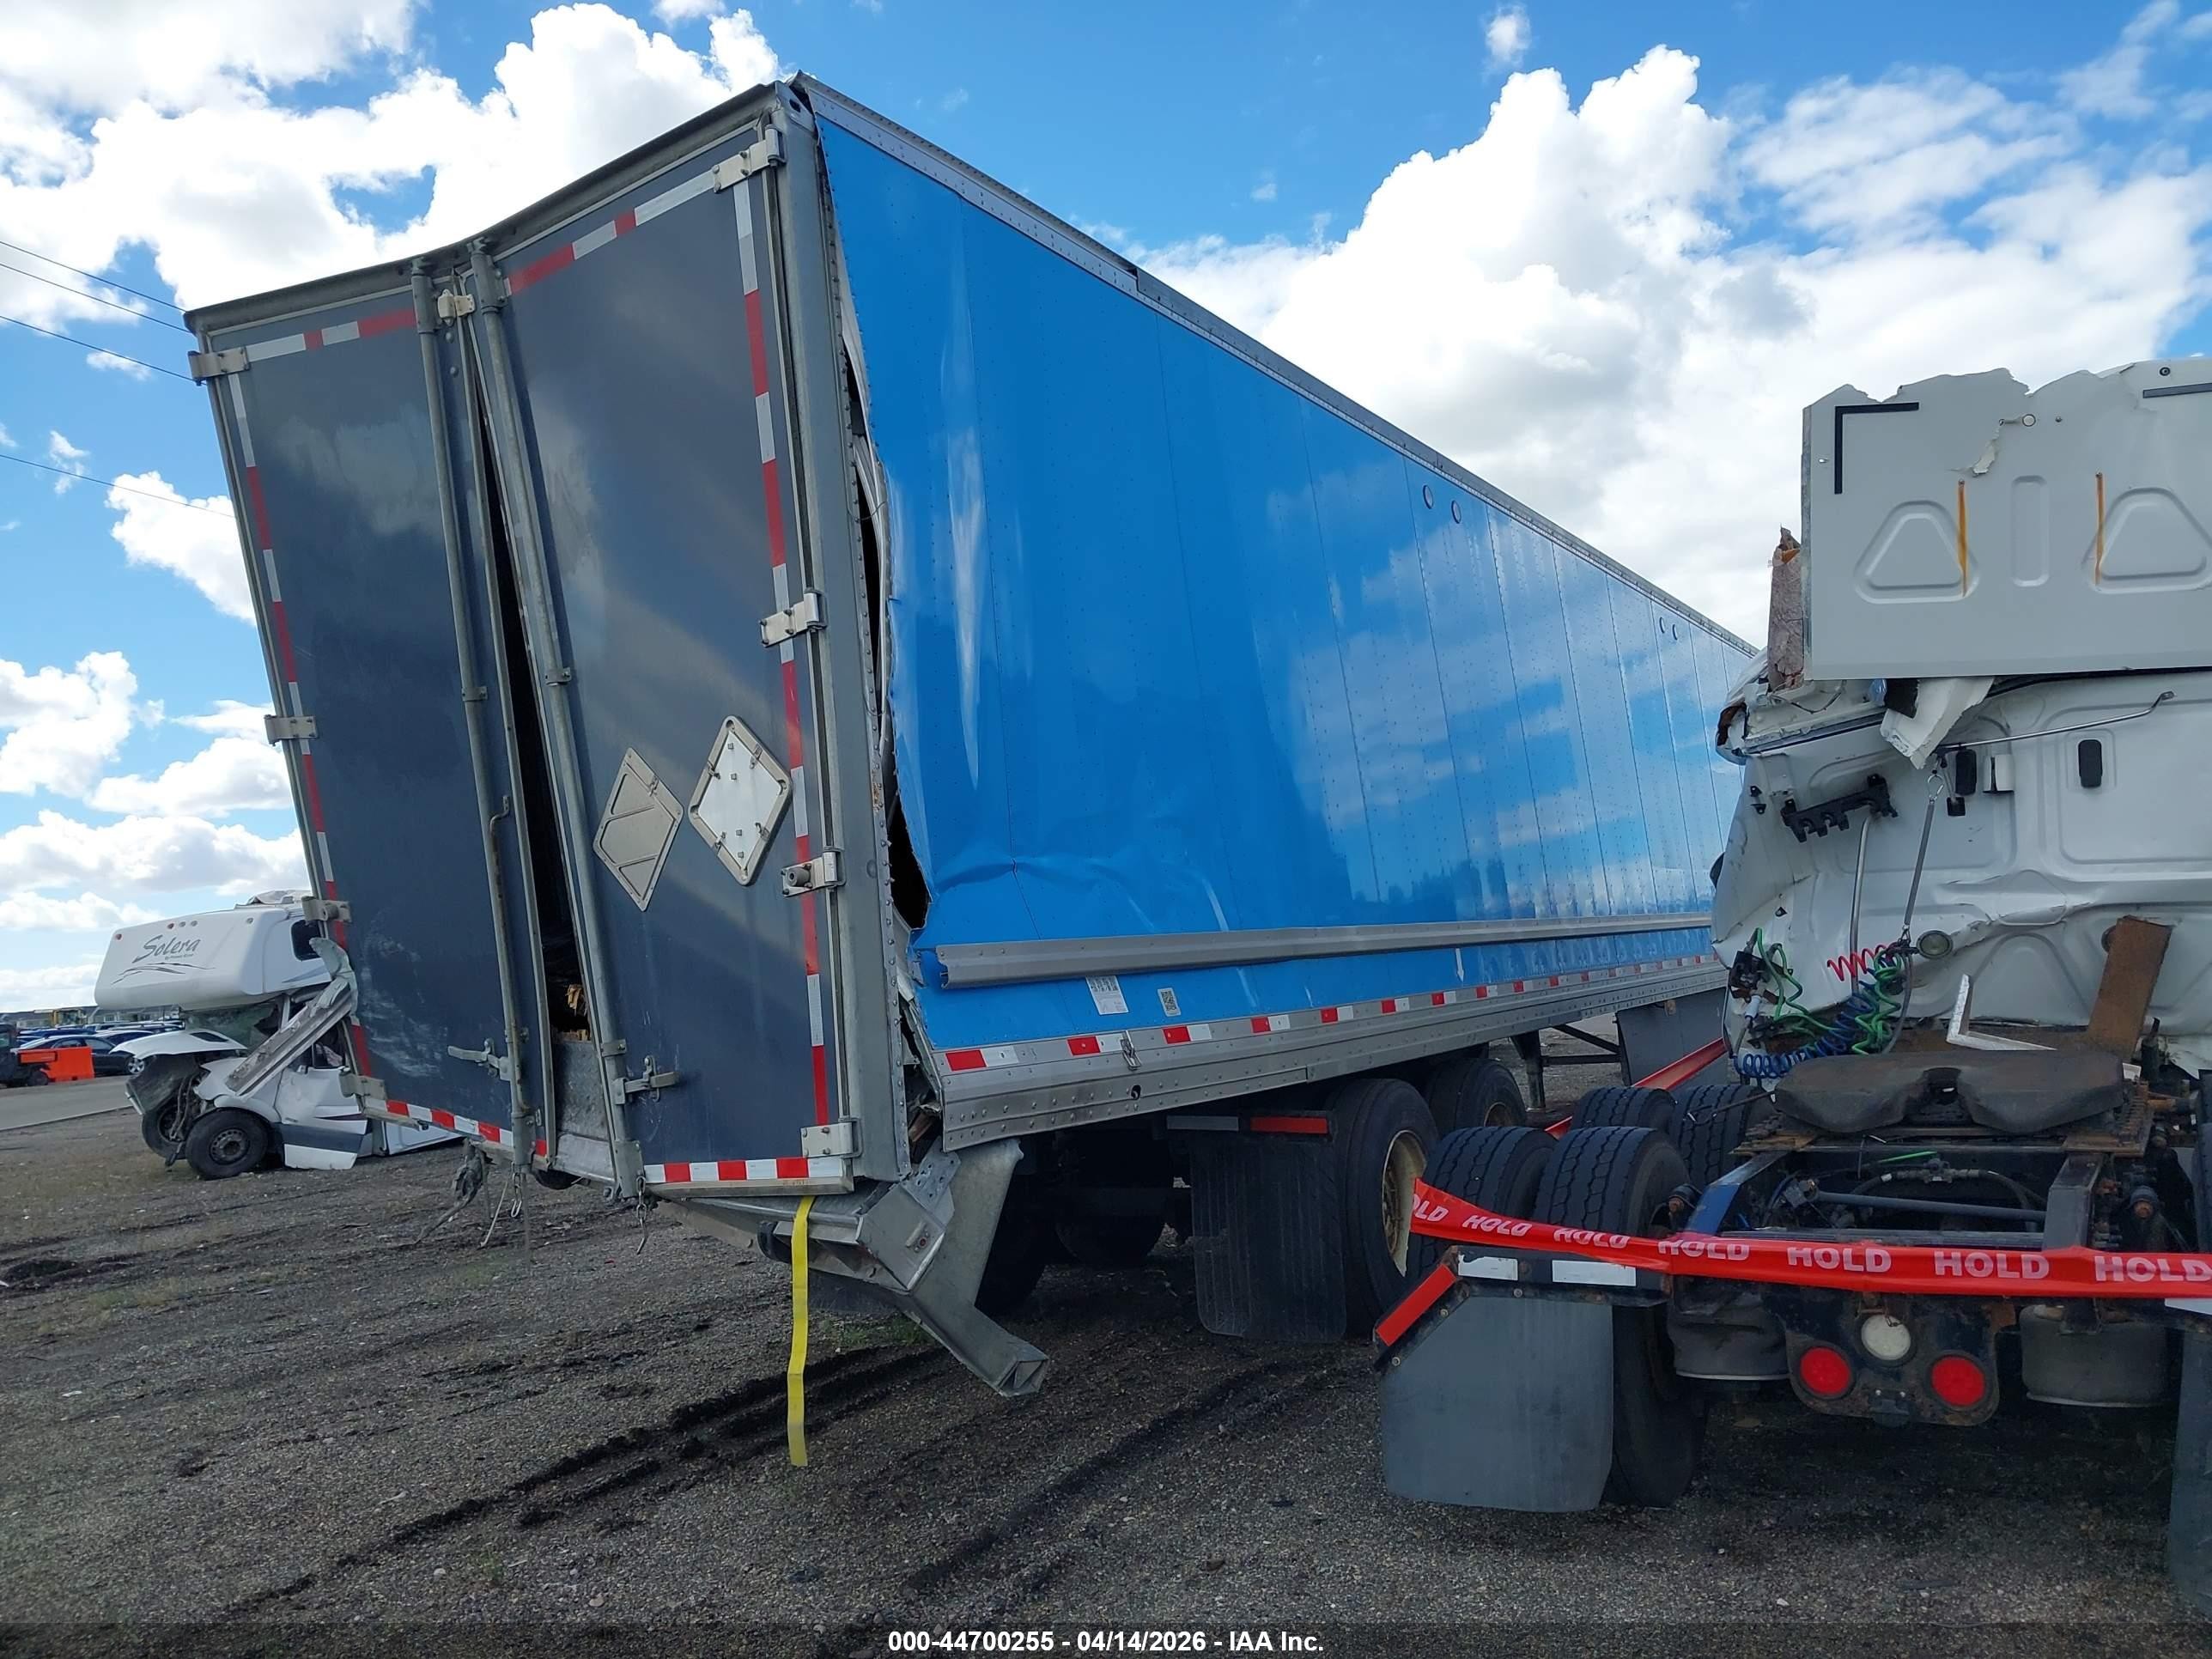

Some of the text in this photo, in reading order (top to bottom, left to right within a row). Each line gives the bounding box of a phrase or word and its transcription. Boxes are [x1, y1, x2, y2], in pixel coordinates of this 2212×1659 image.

[131, 934, 201, 963] Solera
[1462, 1214, 1533, 1237] HOLD
[1553, 1227, 1631, 1249] HOLD
[1657, 1239, 1750, 1261] HOLD
[1787, 1247, 1892, 1273] HOLD
[1934, 1250, 2050, 1279] HOLD
[2094, 1255, 2212, 1282] HOLD
